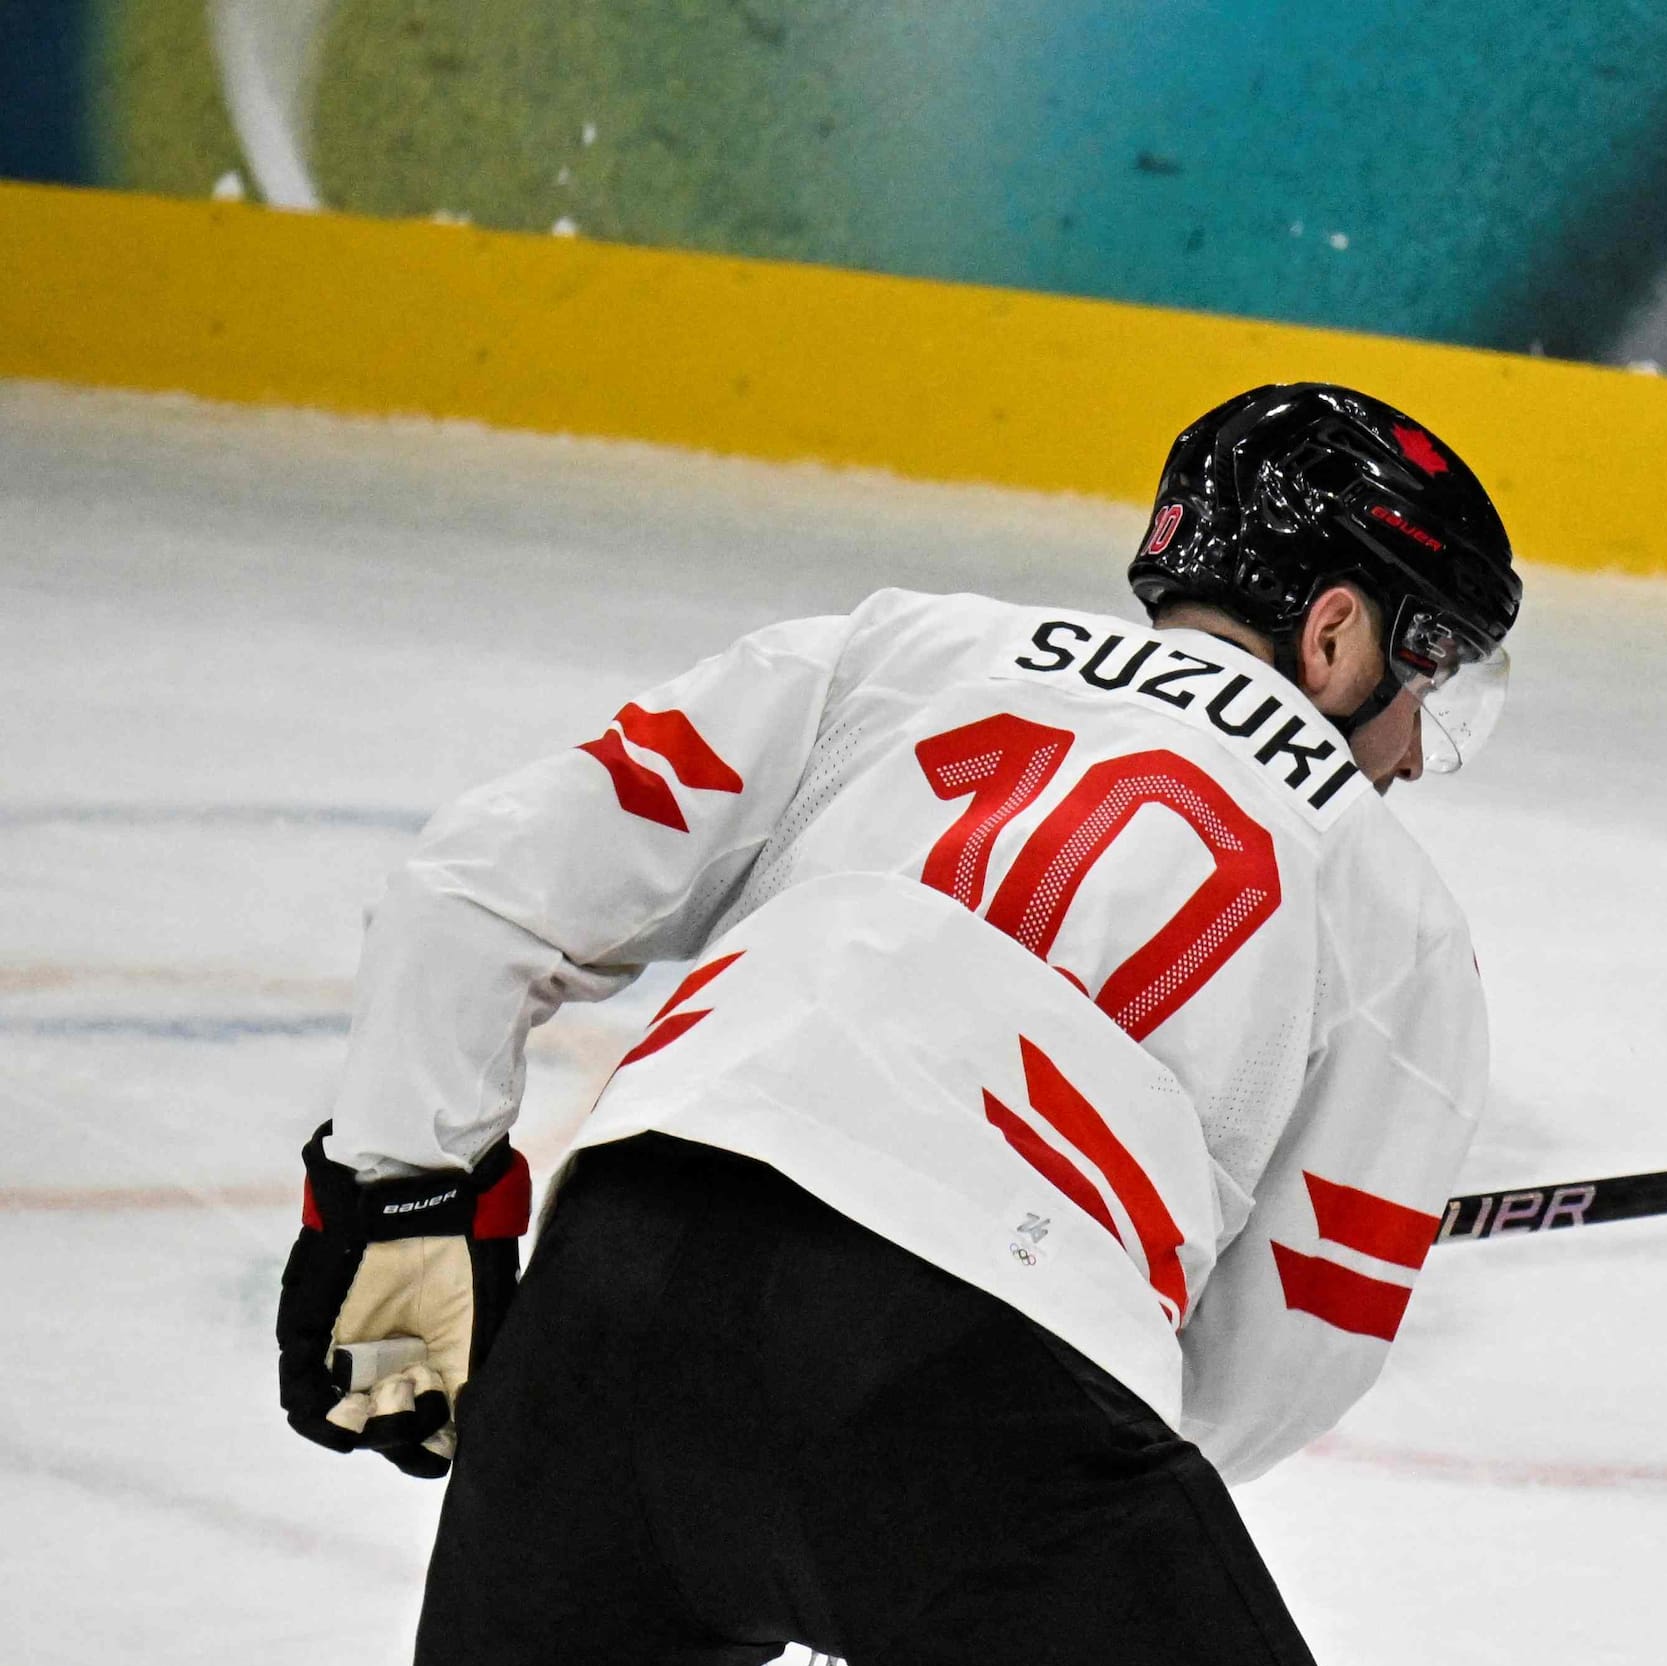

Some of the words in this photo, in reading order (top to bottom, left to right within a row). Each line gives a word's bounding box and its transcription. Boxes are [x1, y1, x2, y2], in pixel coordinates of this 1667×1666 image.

[1141, 504, 1183, 556] 10
[1371, 505, 1442, 552] BAUER
[1015, 621, 1359, 810] SUZUKI
[915, 713, 1281, 1042] 10
[383, 1189, 457, 1214] BAUER
[1437, 1184, 1596, 1244] UER
